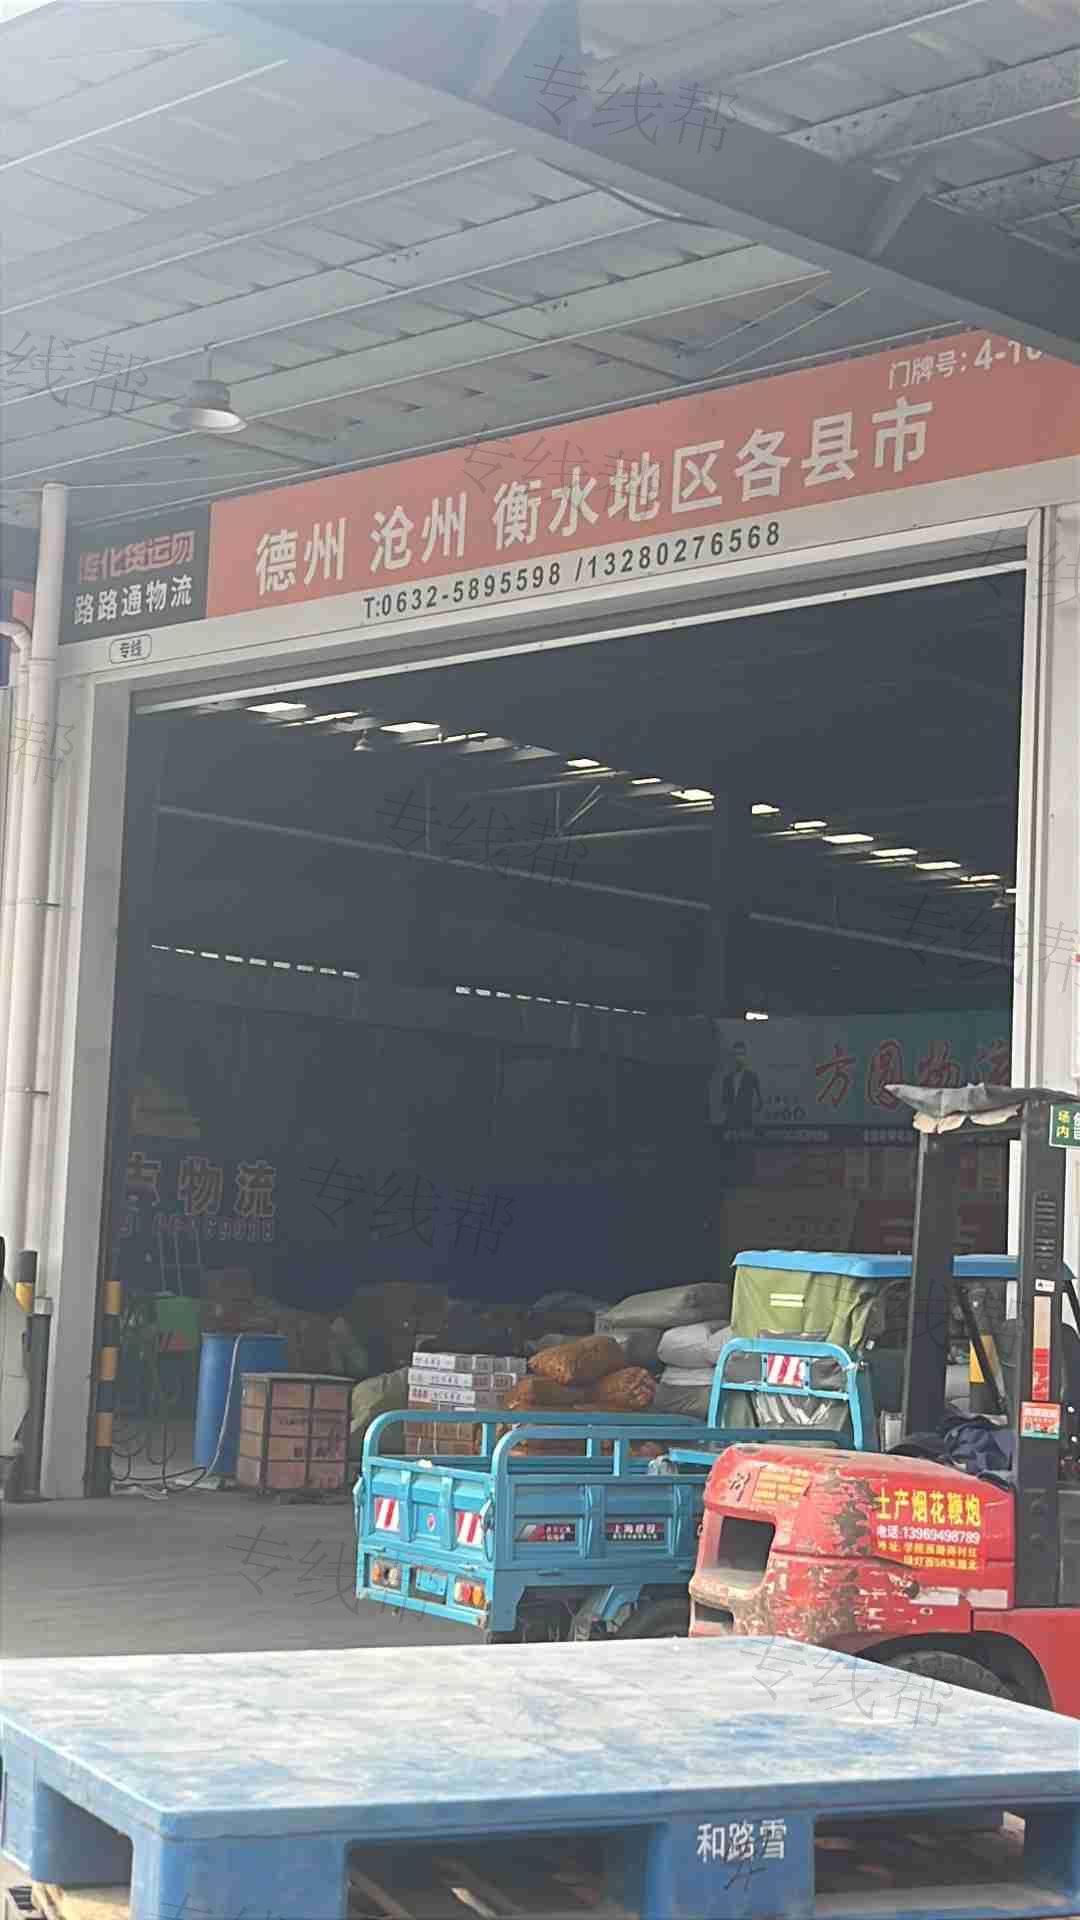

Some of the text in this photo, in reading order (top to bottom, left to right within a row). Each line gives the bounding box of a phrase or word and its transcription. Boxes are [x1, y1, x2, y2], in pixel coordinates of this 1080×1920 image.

[255, 395, 934, 595] 德州 沧州 衡水地区各县市
[74, 574, 192, 625] 路路通物流
[364, 562, 561, 619] T:0632-5895598
[120, 639, 142, 659] 专线
[874, 1487, 981, 1527] 土产烟花鞭炮
[697, 1818, 788, 1863] 和路雪
